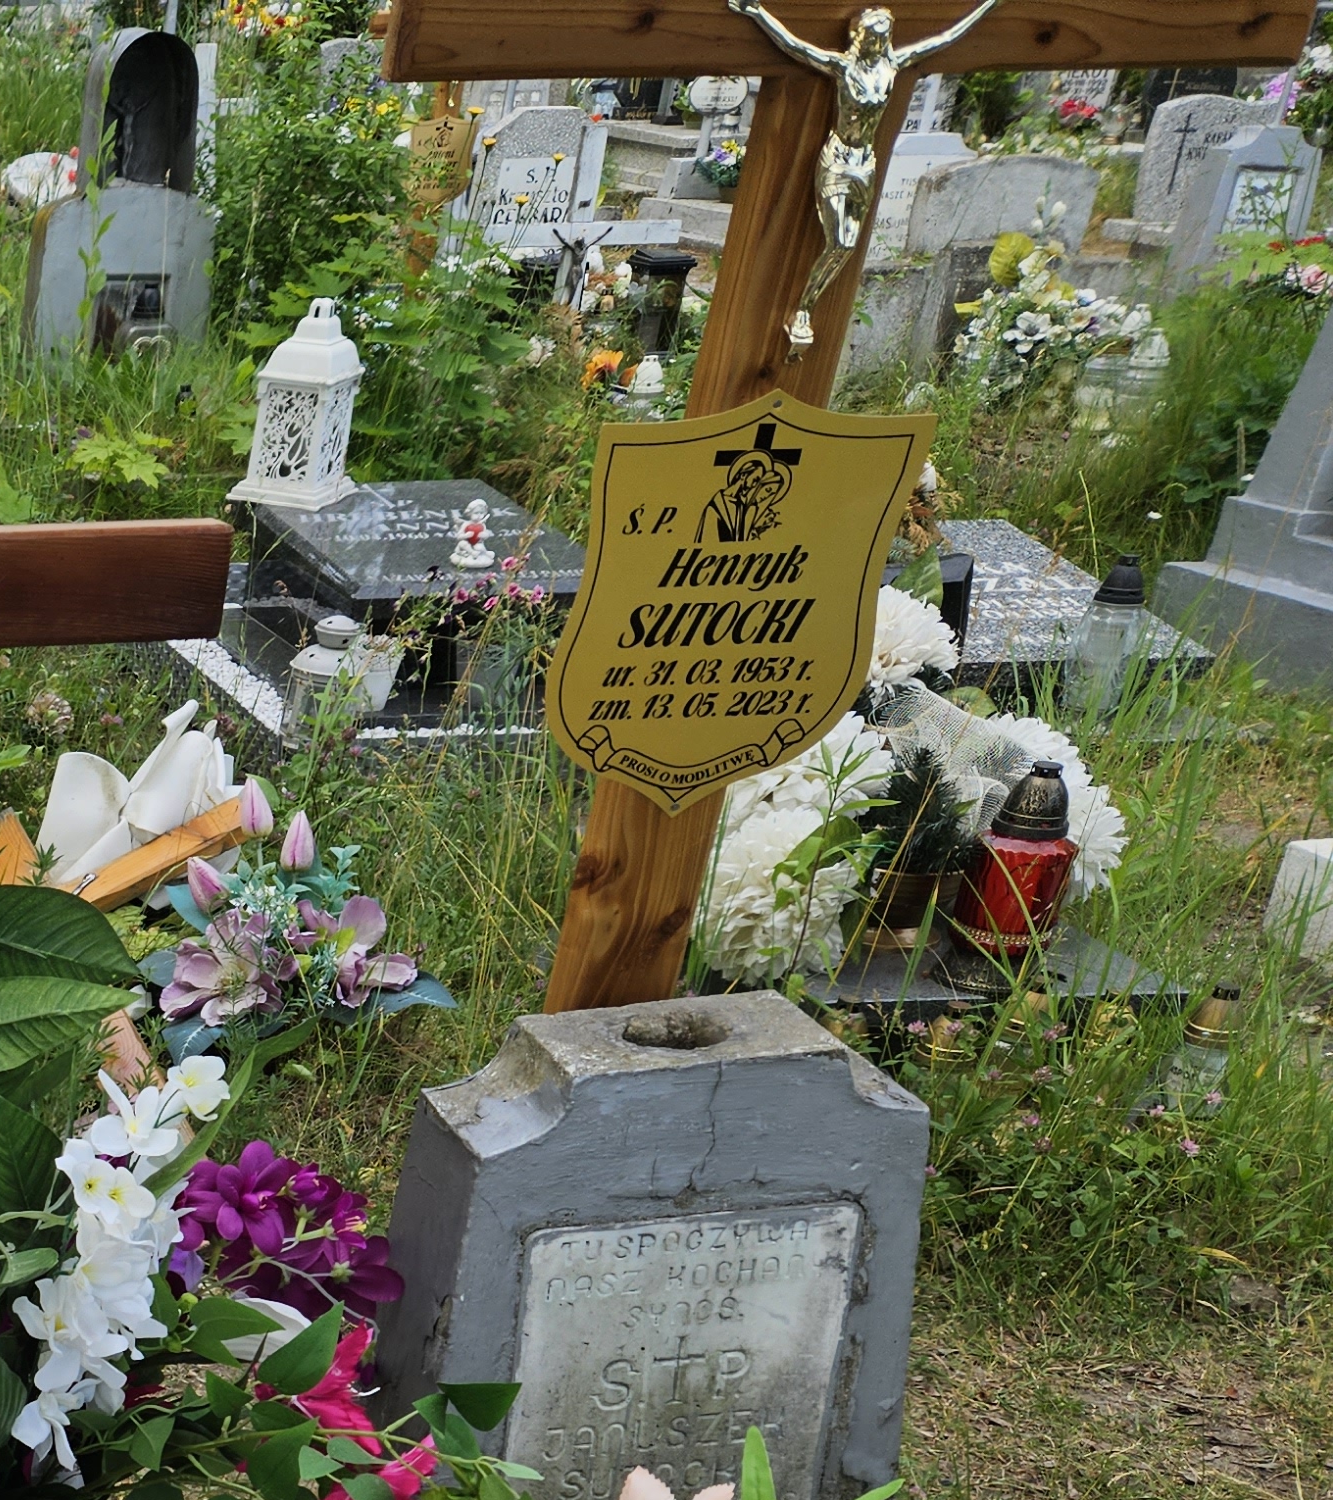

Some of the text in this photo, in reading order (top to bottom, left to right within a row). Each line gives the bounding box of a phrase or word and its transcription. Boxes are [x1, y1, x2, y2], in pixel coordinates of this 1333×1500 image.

[651, 505, 678, 535] P.
[657, 544, 810, 592] Henryk
[617, 597, 816, 650] SUTOCKI
[601, 655, 813, 689] ur. 31. 03. 1953 r.
[587, 689, 813, 723] zm. 13. 05. 2023 r.
[618, 748, 756, 785] PROSI O MODLITWĘ
